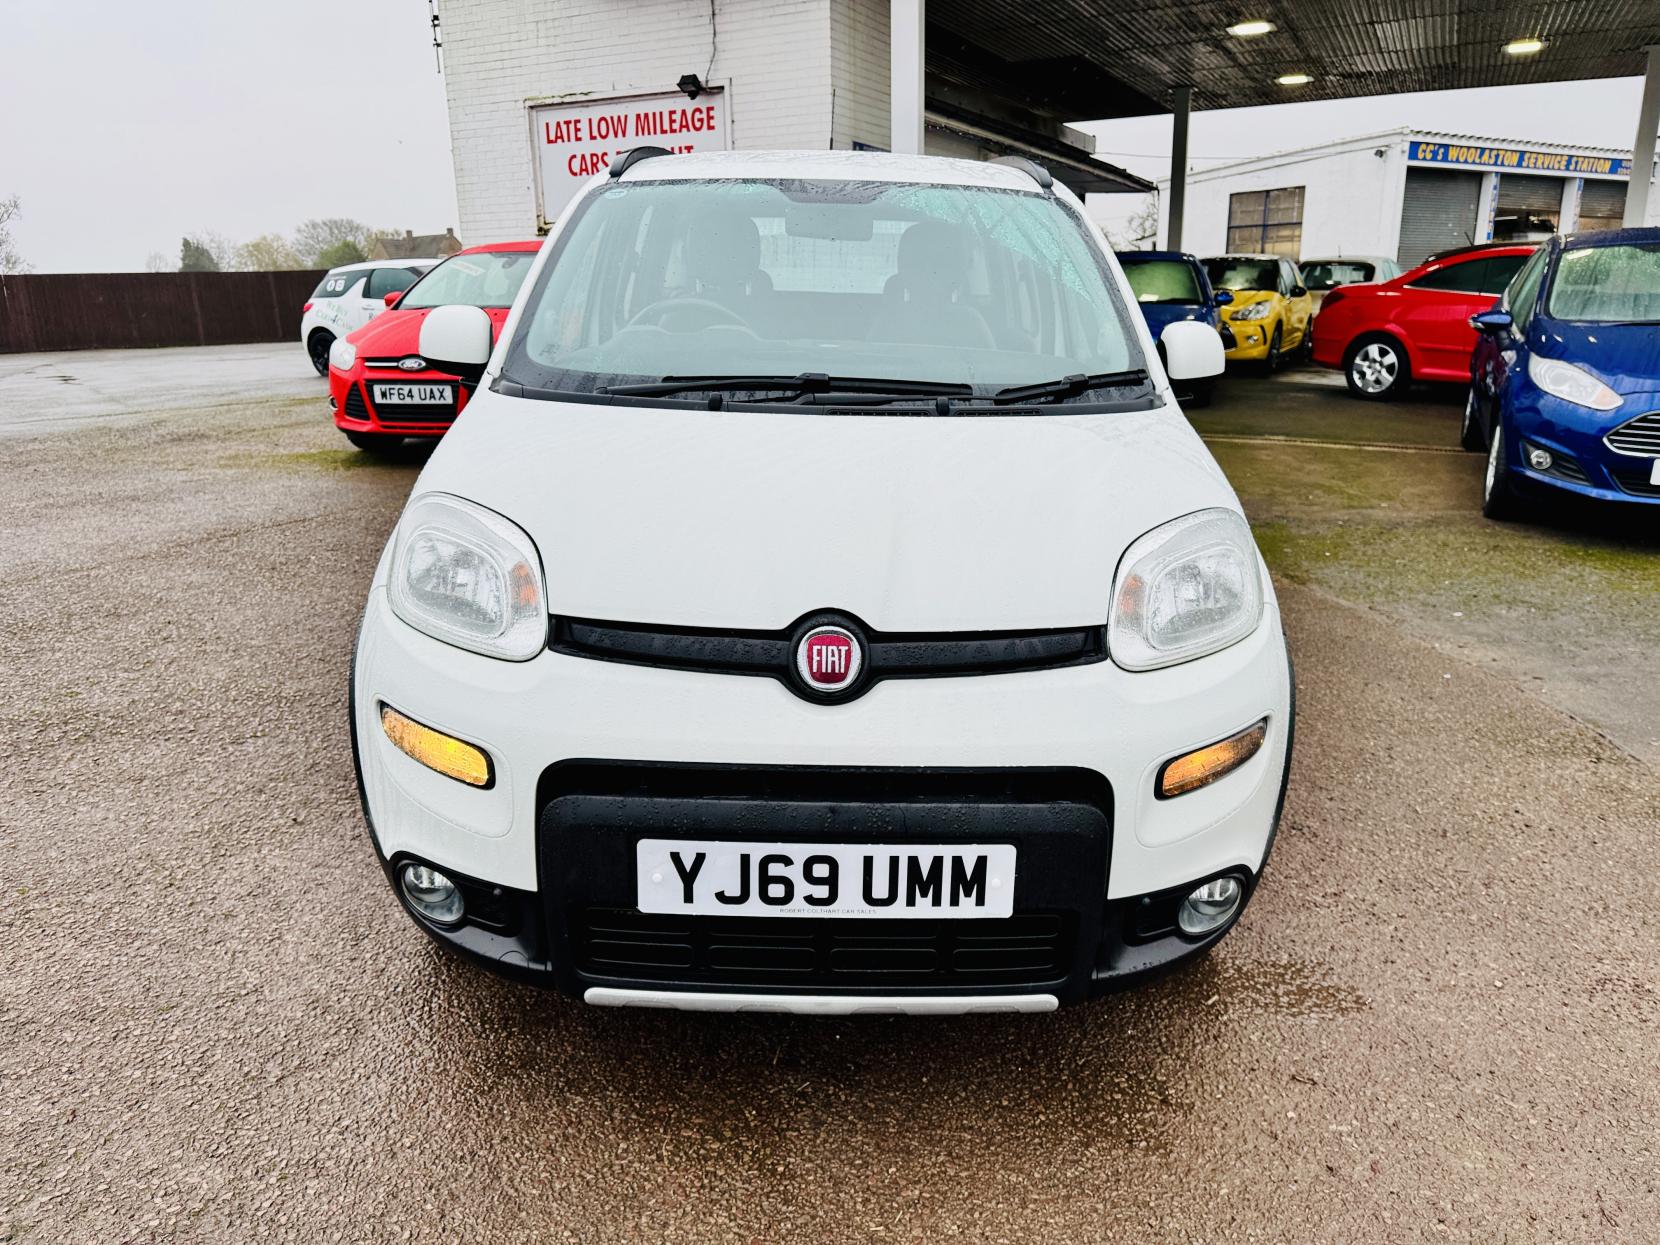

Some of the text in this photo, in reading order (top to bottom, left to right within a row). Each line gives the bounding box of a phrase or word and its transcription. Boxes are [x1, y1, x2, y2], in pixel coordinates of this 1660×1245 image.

[545, 106, 716, 144] LATE LOW MILEAGE
[567, 152, 609, 177] CARS
[1447, 145, 1520, 167] WOOLASTON
[1522, 151, 1569, 171] SERVICE
[1569, 156, 1612, 174] STATION
[379, 387, 447, 401] WF64 UAX
[812, 645, 849, 673] FIAT
[669, 852, 988, 907] YJ69 UMM
